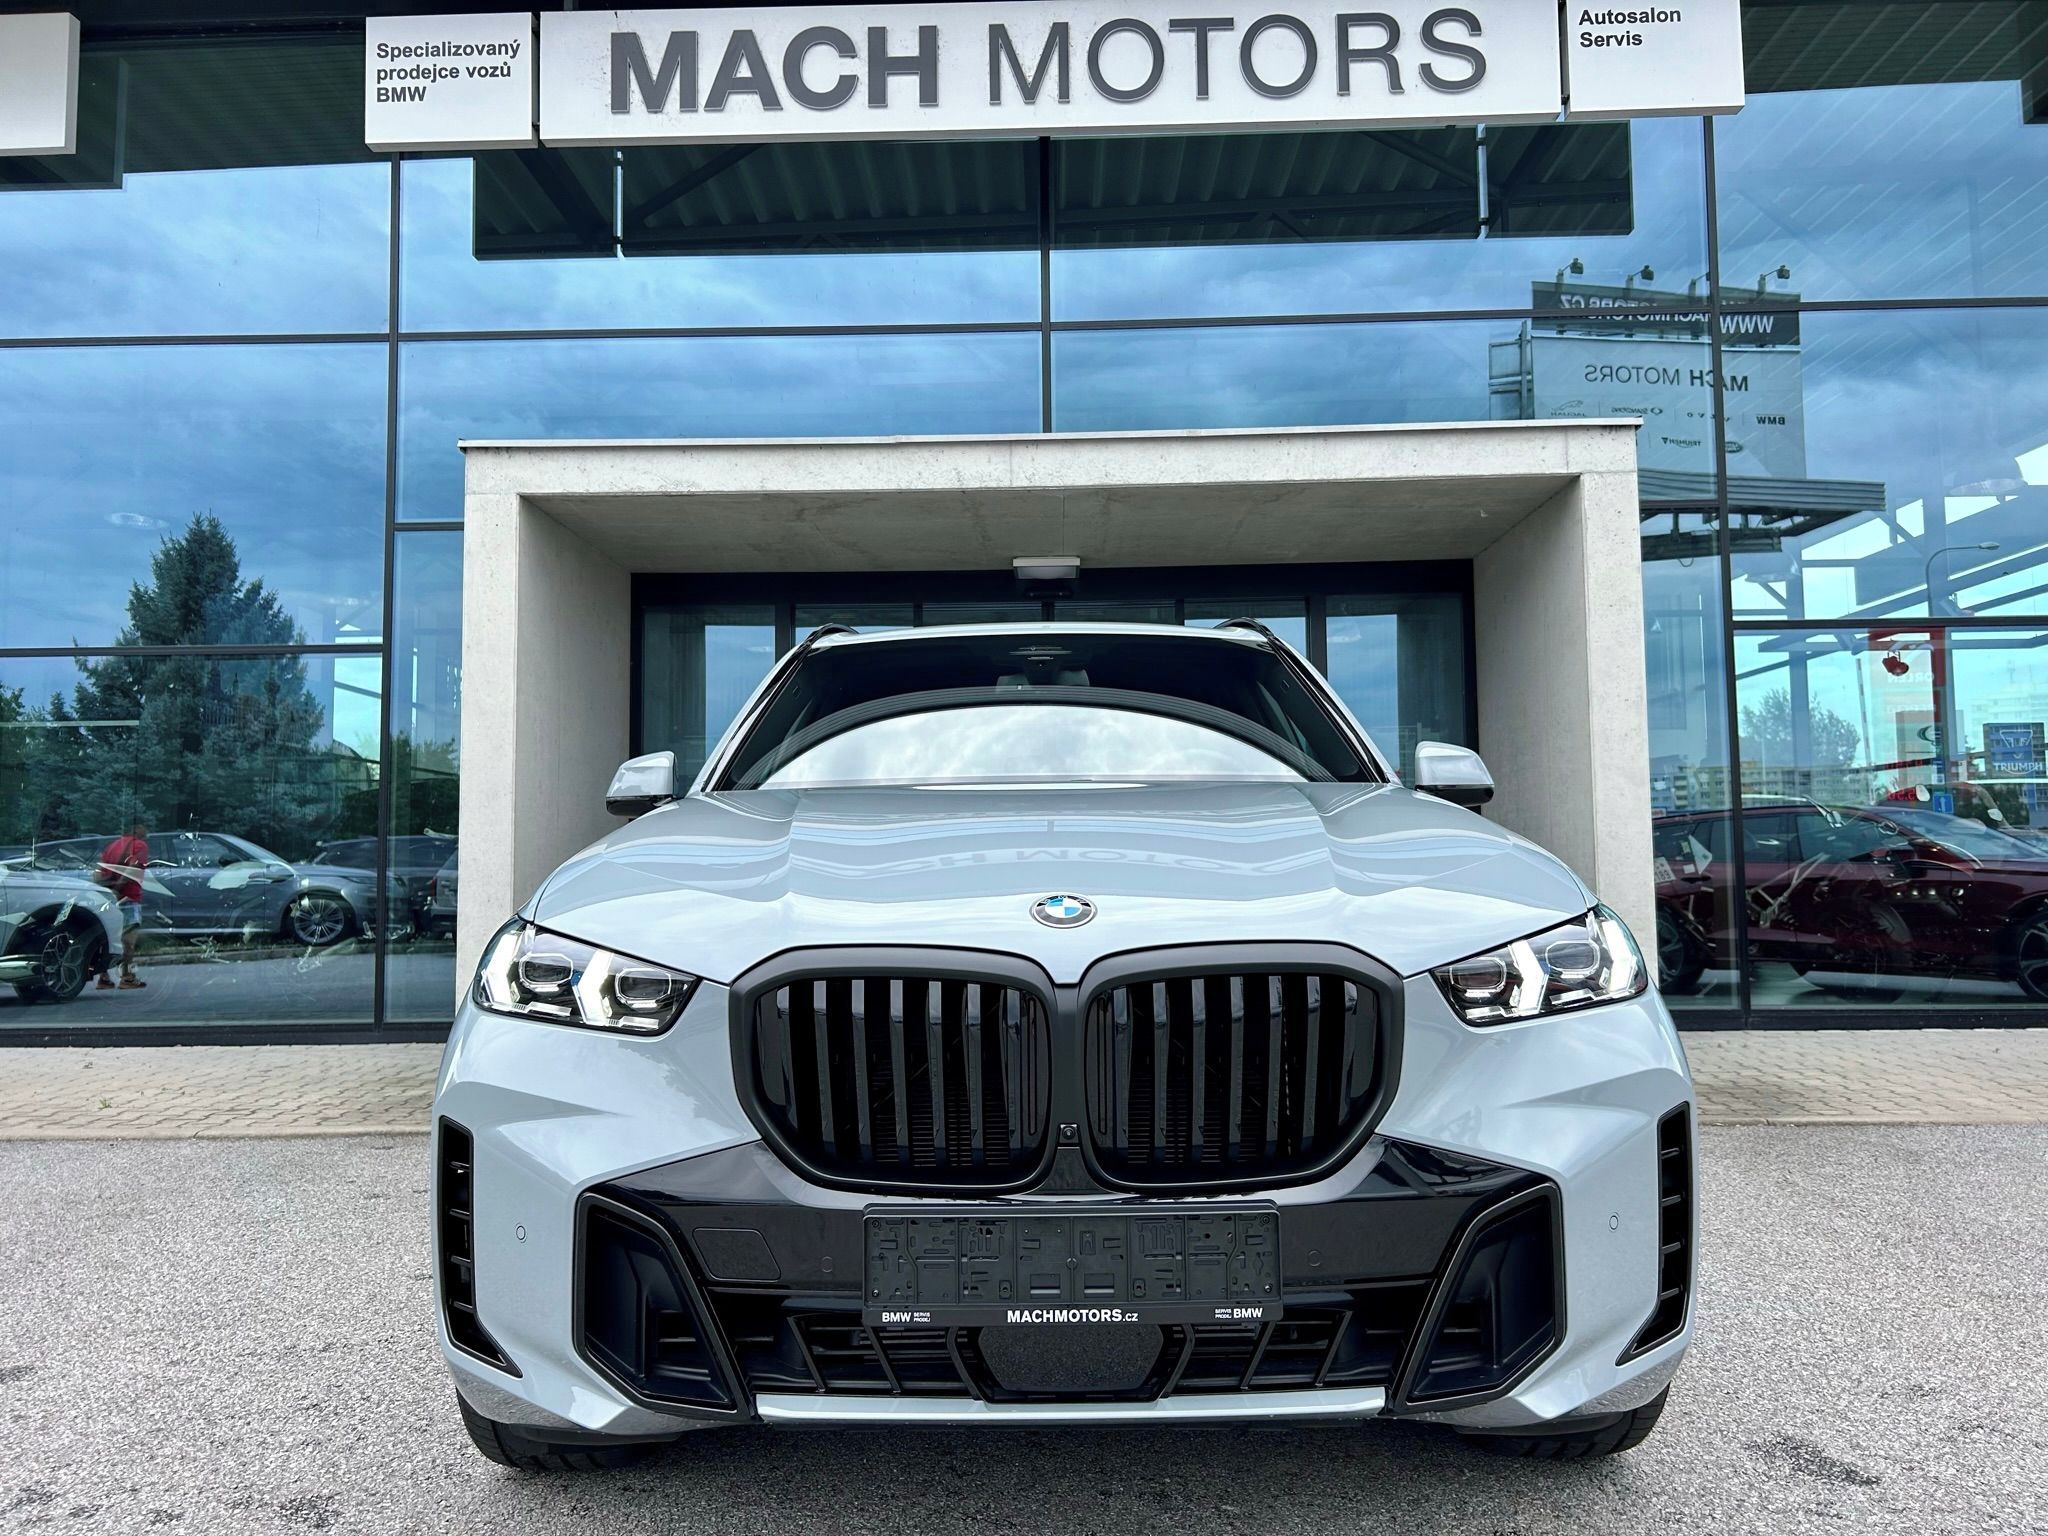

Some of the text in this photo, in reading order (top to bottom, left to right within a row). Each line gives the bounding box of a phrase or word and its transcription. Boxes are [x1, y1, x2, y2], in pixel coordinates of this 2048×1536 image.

[1579, 7, 1682, 26] Autosalon
[1580, 29, 1644, 48] Servis
[376, 39, 521, 62] Specializovaný
[610, 8, 1488, 114] MACH MOTORS
[376, 60, 512, 83] prodejce vozů
[376, 86, 427, 103] BMW
[1992, 762, 2043, 773] TRIUMPH
[881, 1311, 912, 1323] BMW
[1007, 1308, 1139, 1323] MACHMOTORS.cz
[1233, 1307, 1263, 1319] BMW
